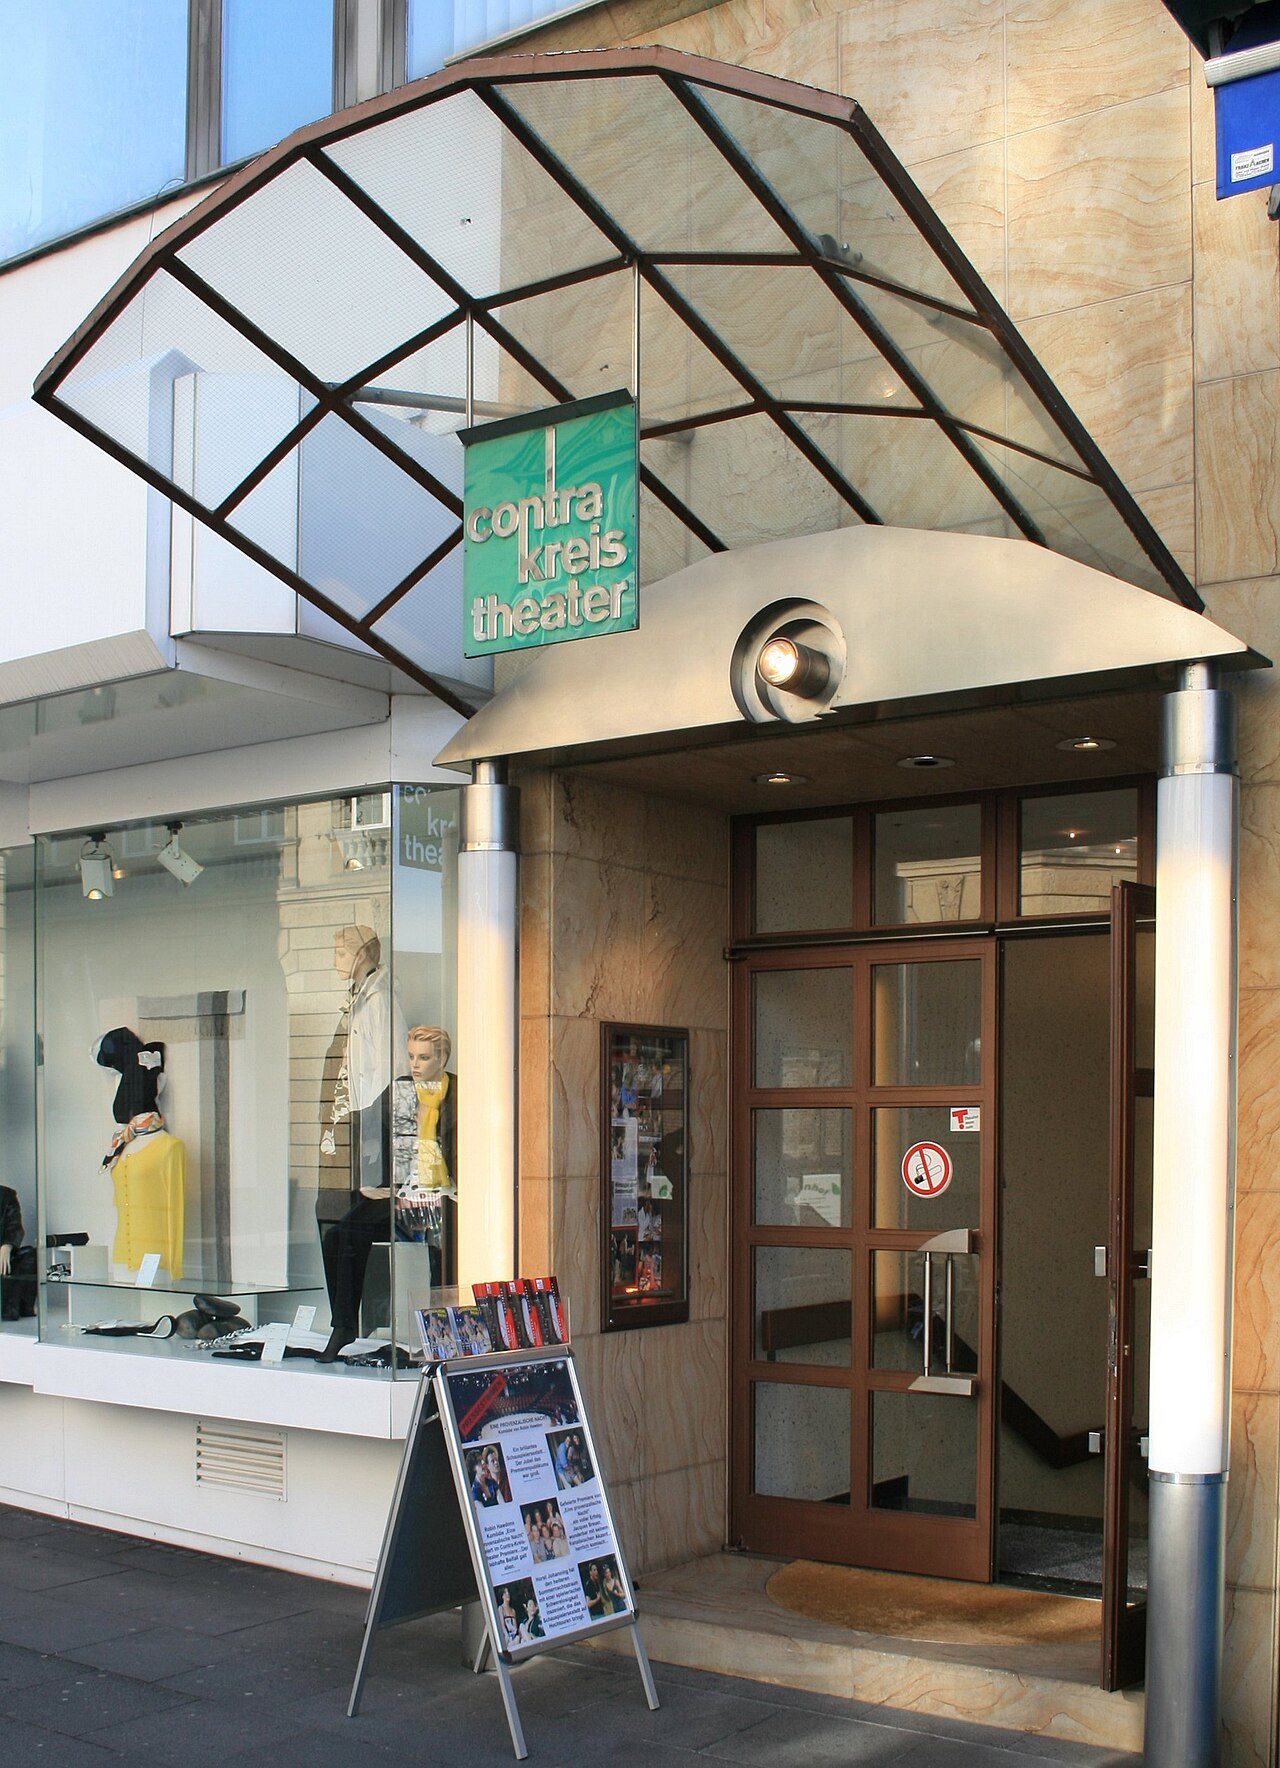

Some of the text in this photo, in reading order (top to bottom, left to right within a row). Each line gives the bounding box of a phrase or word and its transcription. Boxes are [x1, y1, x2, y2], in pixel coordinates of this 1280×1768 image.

[466, 481, 603, 543] contra
[518, 522, 628, 584] kreis
[471, 578, 629, 642] theater
